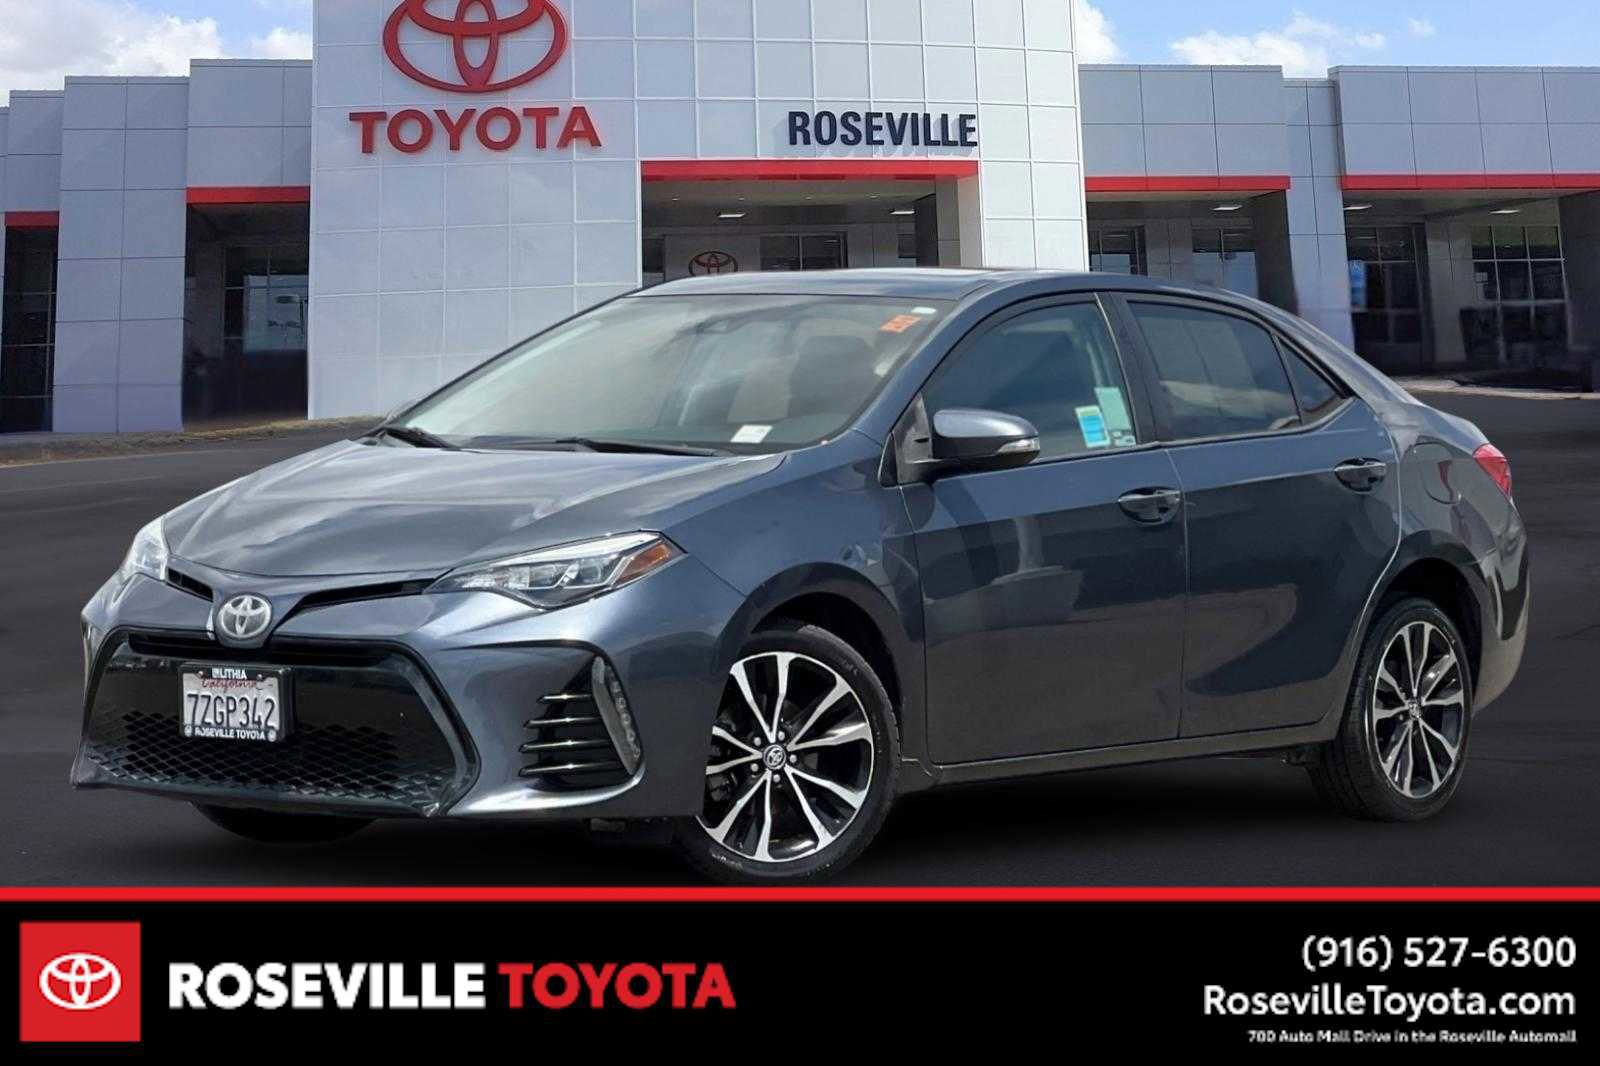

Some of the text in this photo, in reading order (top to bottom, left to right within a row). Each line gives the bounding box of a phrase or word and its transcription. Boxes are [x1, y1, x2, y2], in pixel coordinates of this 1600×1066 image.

[349, 106, 602, 154] TOYOTA
[788, 111, 978, 147] ROSEVILLE
[219, 668, 247, 680] LITHIA
[187, 693, 275, 731] 7ZGP342
[194, 727, 266, 740] ROSEVILLE TOYOTA
